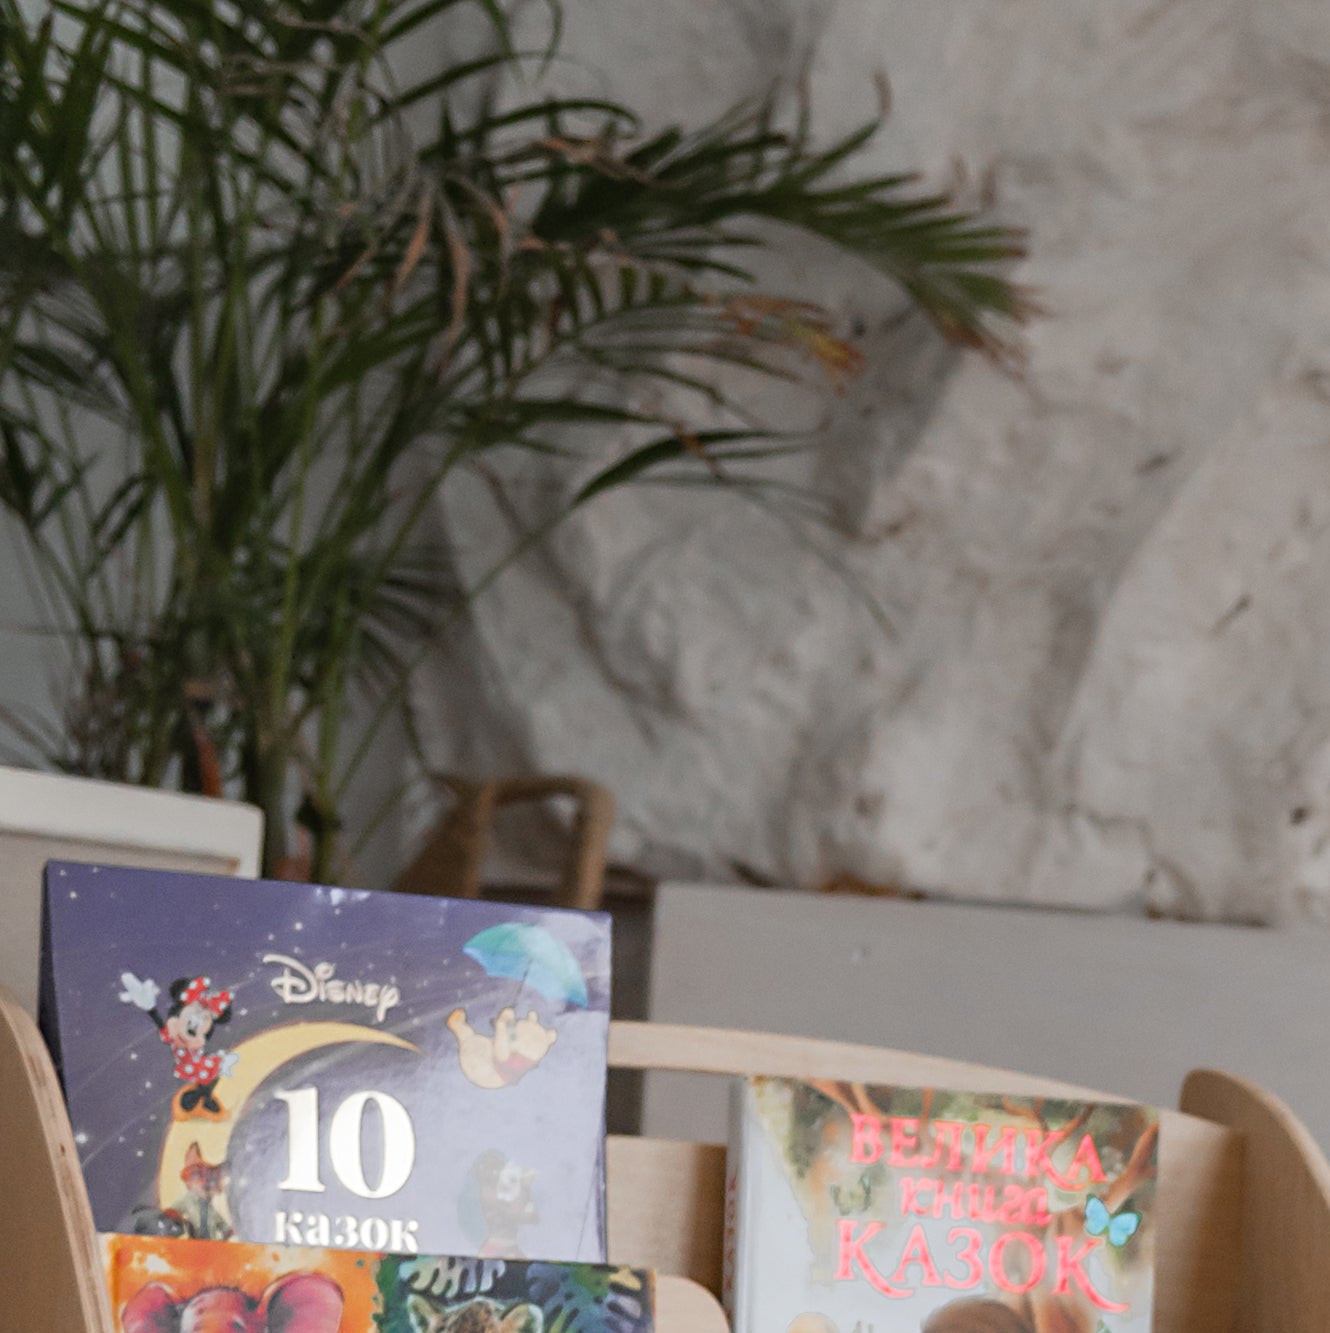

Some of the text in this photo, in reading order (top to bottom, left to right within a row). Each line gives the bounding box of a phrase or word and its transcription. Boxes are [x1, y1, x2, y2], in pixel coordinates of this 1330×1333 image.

[263, 953, 400, 1022] Disney
[273, 1086, 416, 1199] 10
[848, 1112, 1107, 1191] ВЕЛИКА
[274, 1211, 419, 1253] казок
[833, 1220, 1130, 1314] КАЗОК
